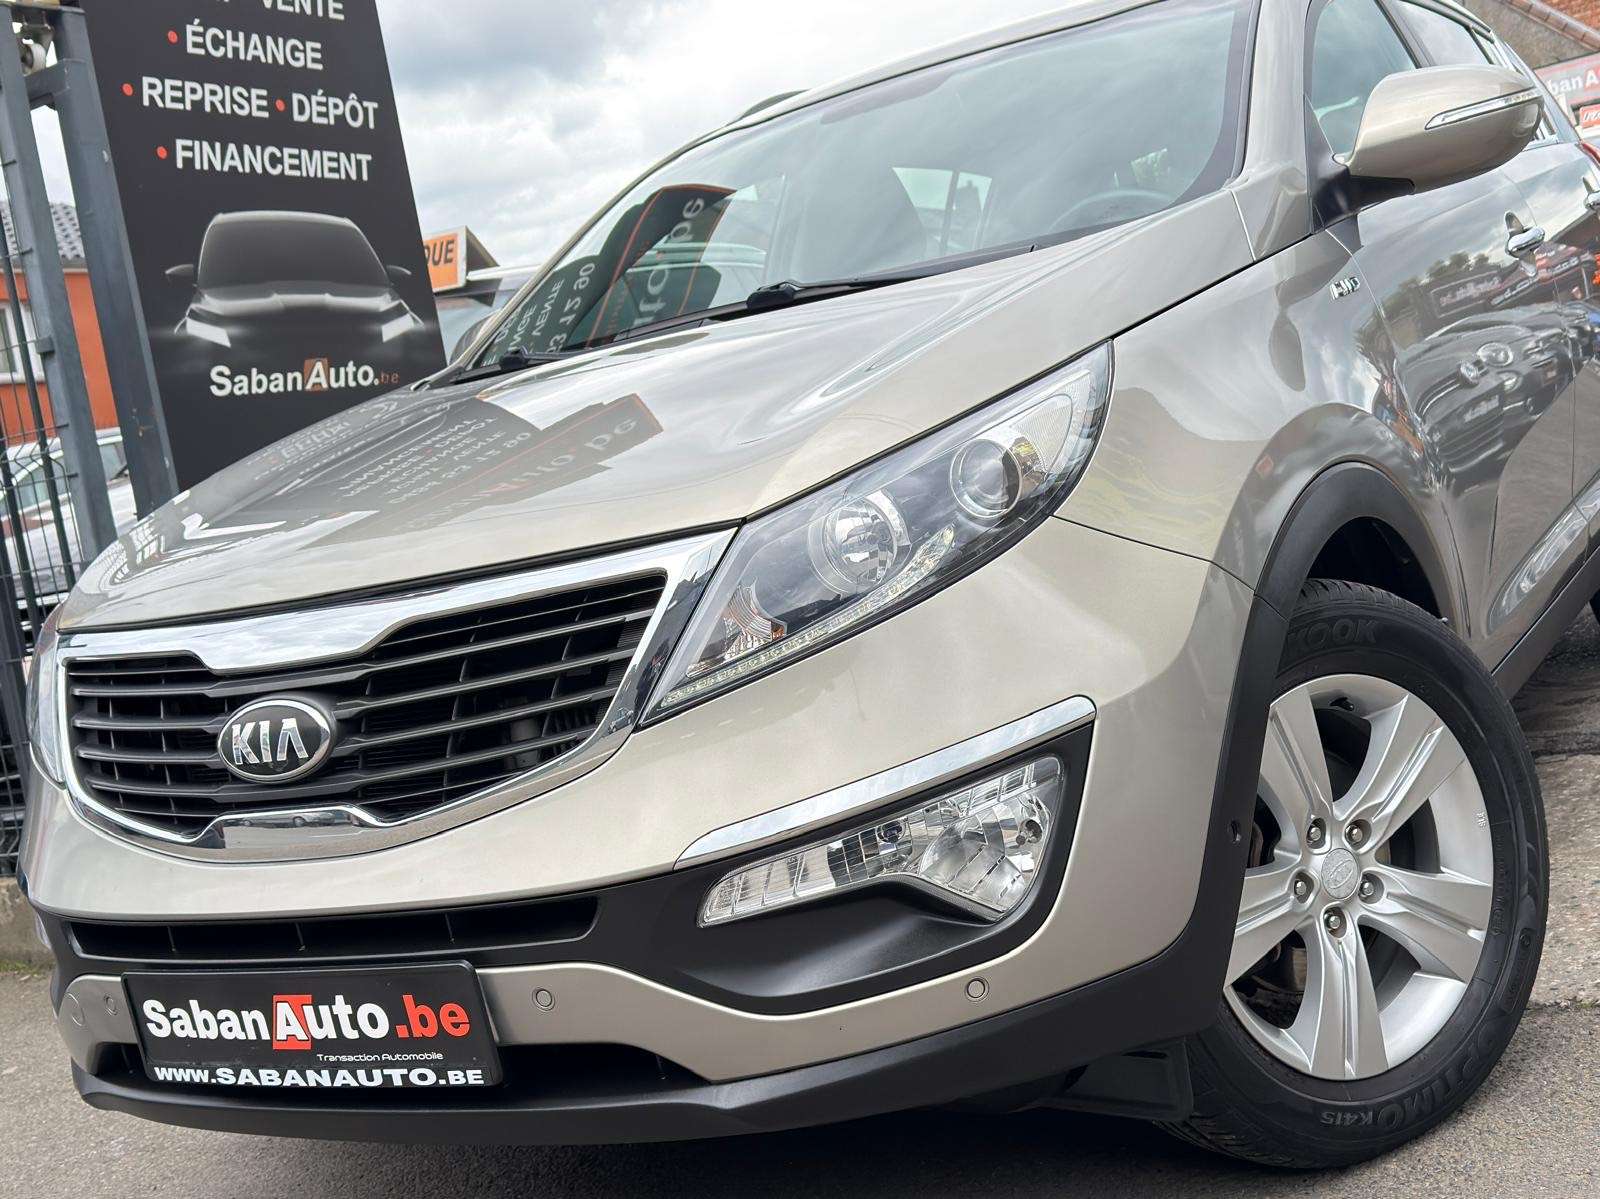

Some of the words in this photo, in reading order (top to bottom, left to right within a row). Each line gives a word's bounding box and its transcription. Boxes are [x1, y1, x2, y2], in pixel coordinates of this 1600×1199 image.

[186, 19, 323, 70] ÉCHANGE
[141, 76, 270, 118] REPRISE
[291, 89, 378, 129] DÉPÔT
[175, 138, 372, 181] FINANCEMENT
[209, 359, 399, 396] SabanAuto.be
[231, 718, 309, 765] KIA
[142, 994, 471, 1045] SabanAuto.be
[154, 1066, 484, 1088] WWW.SABANAUTO.BE
[317, 1053, 380, 1063] Transaction
[381, 1051, 444, 1062] Automobile
